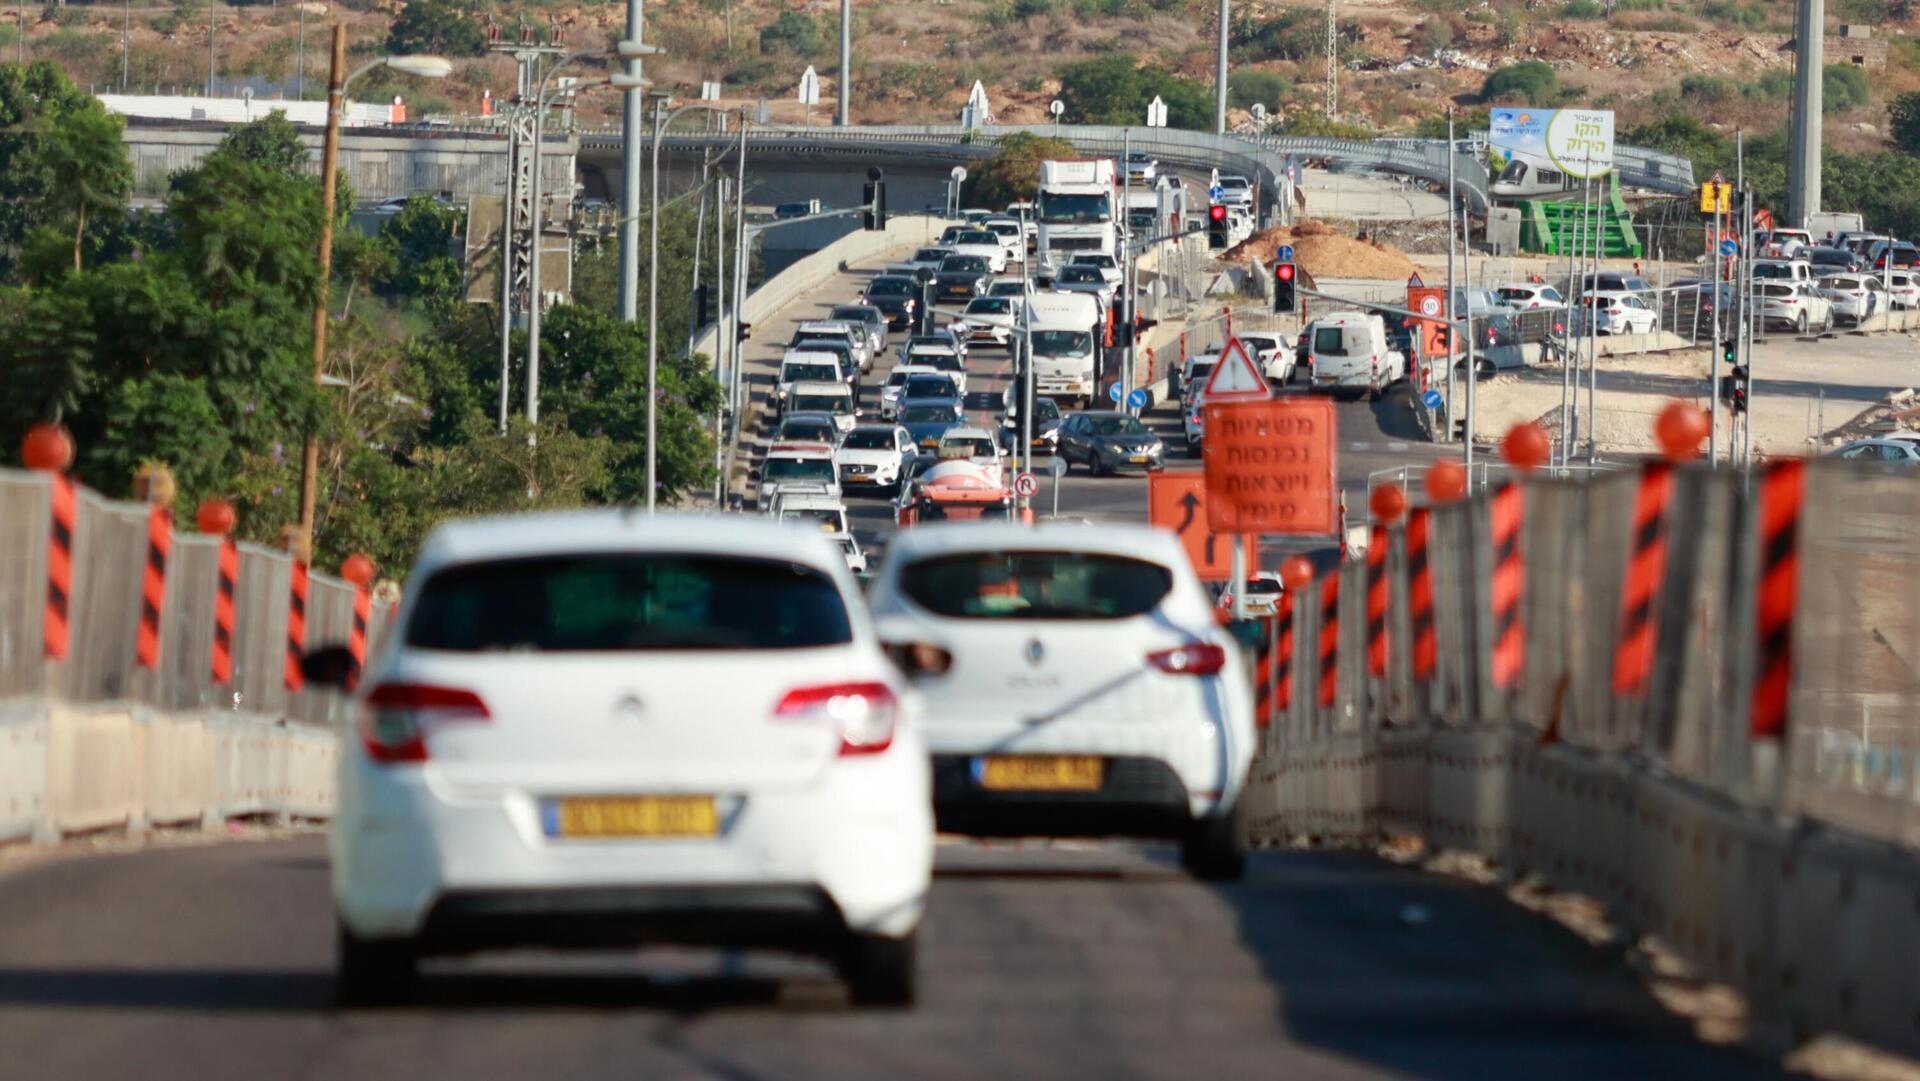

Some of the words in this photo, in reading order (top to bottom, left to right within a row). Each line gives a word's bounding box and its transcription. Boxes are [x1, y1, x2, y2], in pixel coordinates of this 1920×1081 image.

[1575, 123, 1601, 138] הקו
[1567, 138, 1606, 153] הירוק
[1221, 418, 1314, 437] משאיות
[1227, 446, 1310, 464] נכנסות
[1225, 474, 1309, 494] ויוצאות
